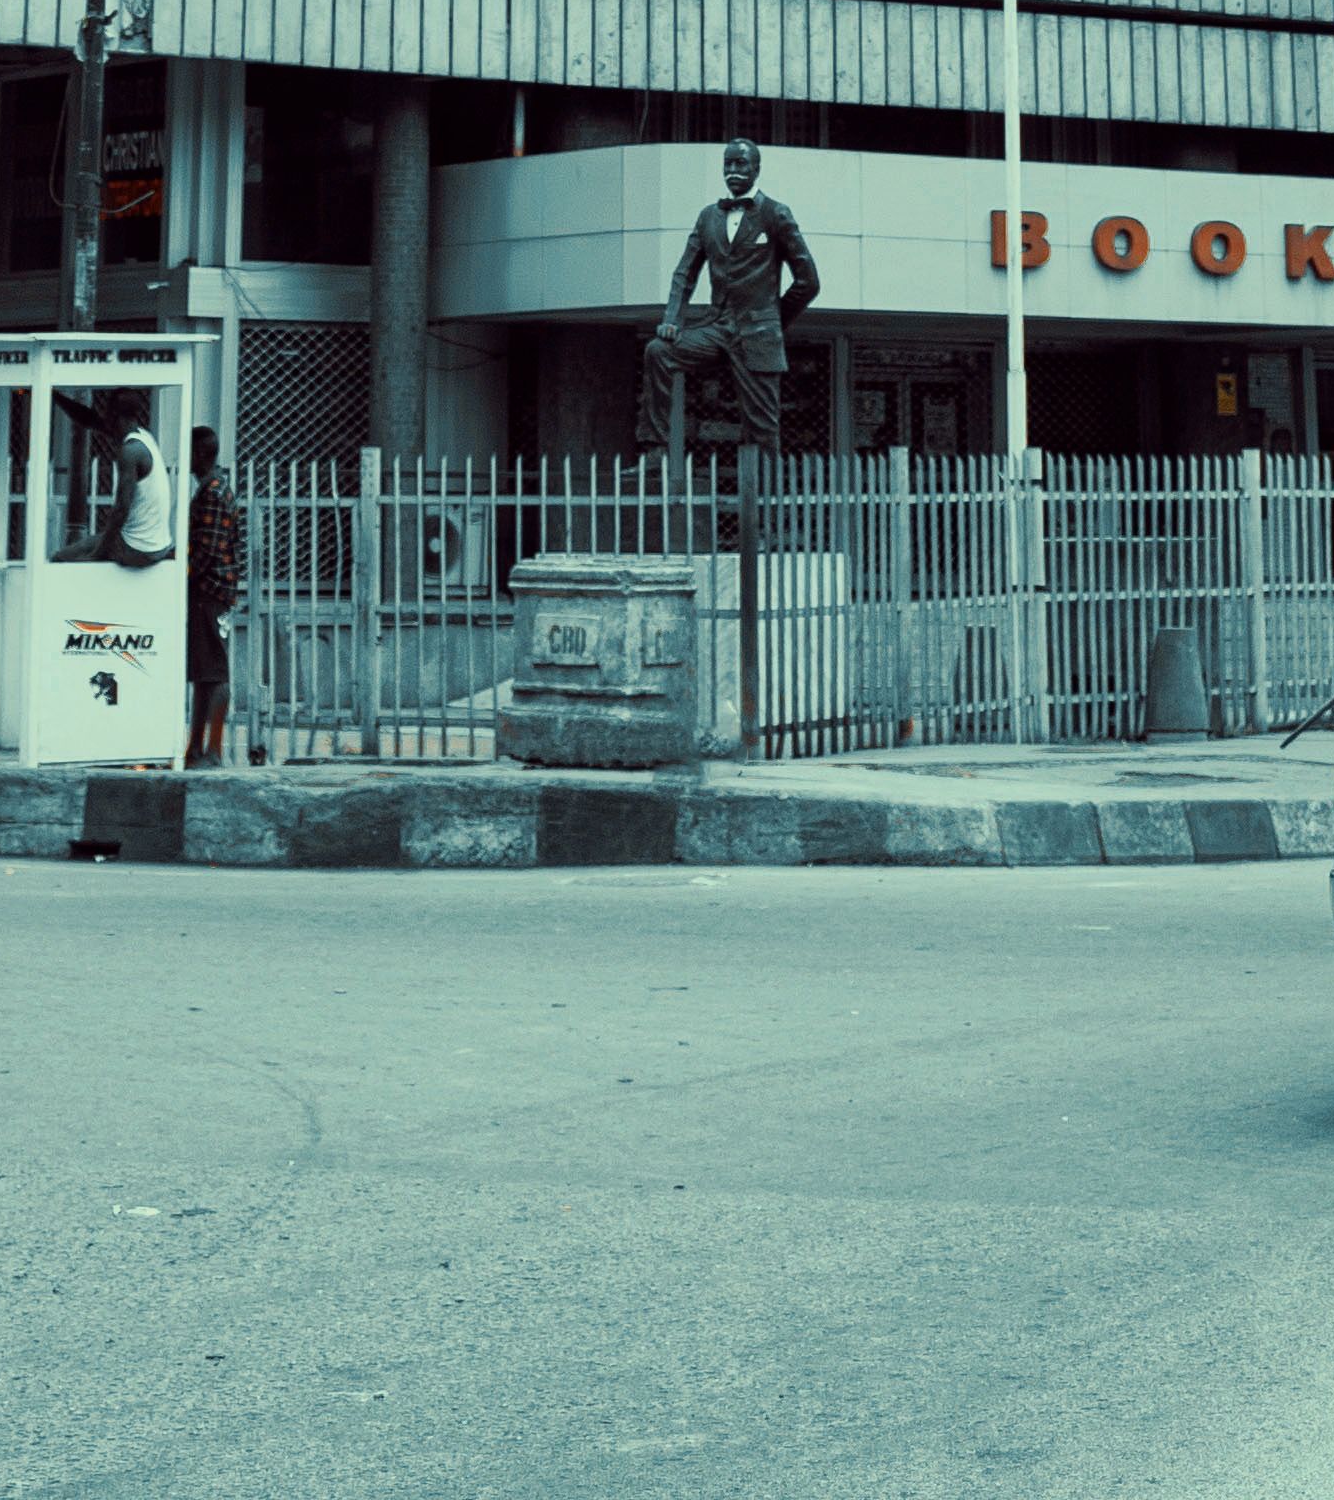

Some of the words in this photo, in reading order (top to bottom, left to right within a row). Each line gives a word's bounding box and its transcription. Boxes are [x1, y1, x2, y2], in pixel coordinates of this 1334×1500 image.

[52, 349, 112, 364] TRAFFIC
[117, 349, 177, 364] OFFICER
[65, 633, 155, 650] MIKANO
